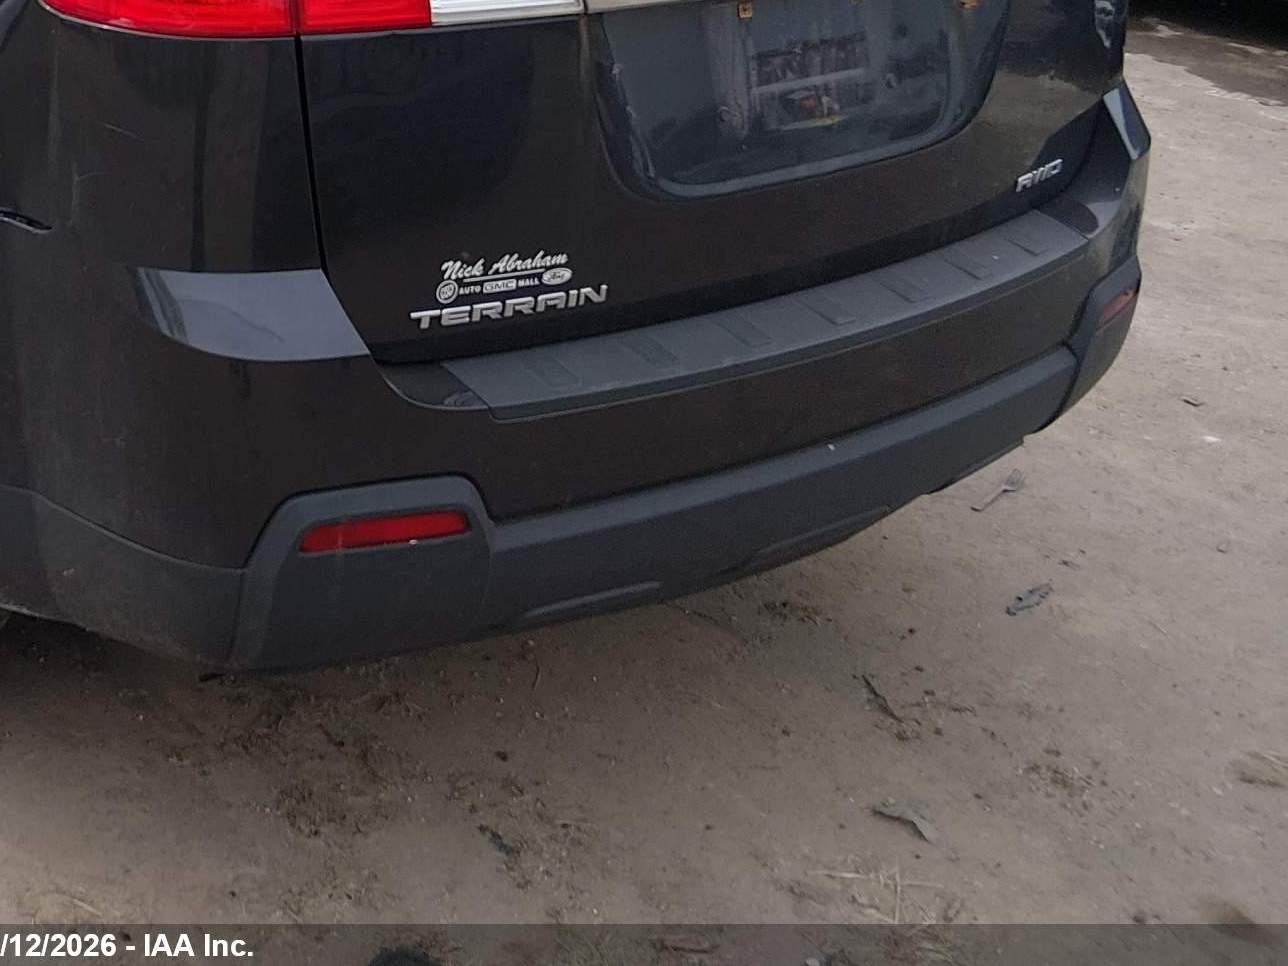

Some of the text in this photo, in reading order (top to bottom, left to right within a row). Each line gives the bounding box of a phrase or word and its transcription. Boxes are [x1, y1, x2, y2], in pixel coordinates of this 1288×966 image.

[441, 250, 569, 280] Nick Abraham
[458, 285, 482, 295] AUTO
[484, 280, 516, 293] GMC
[517, 277, 540, 287] MALL
[410, 284, 609, 330] TERRAIN
